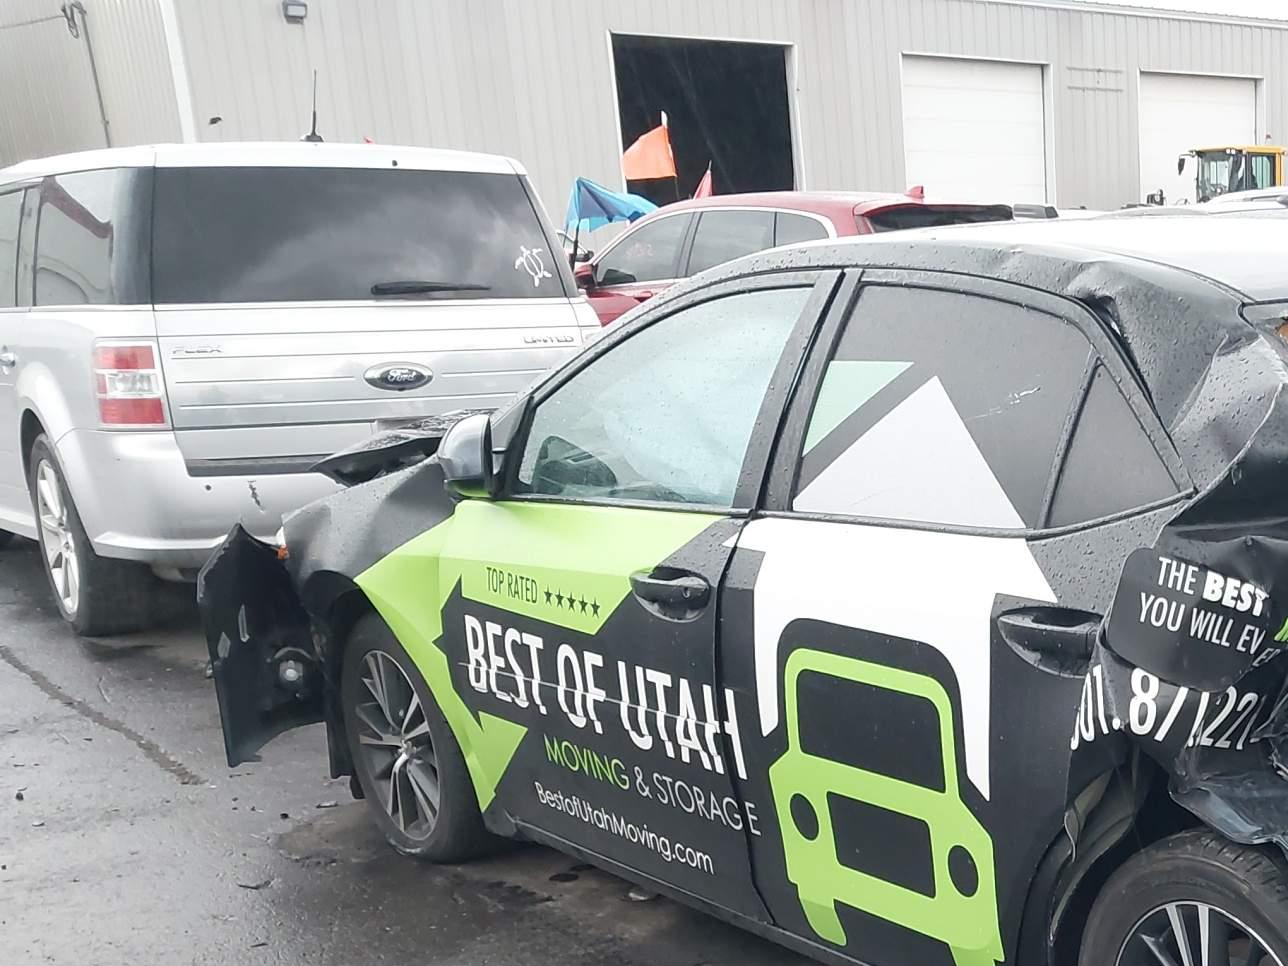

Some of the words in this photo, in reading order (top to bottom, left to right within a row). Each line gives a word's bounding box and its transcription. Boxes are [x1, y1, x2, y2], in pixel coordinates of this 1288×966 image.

[486, 566, 506, 595] TOP
[507, 571, 539, 604] RATED
[1138, 592, 1186, 632] YOU
[1190, 607, 1232, 648] WILL
[1157, 556, 1200, 596] THE
[1202, 570, 1270, 617] BEST
[463, 614, 548, 717] BEST
[556, 643, 607, 736] OF
[617, 660, 748, 780] UTAH
[544, 734, 630, 791] MOVING
[634, 766, 651, 797] &
[653, 772, 762, 837] STORAGE
[534, 781, 715, 875] BestofUtahMoving.com
